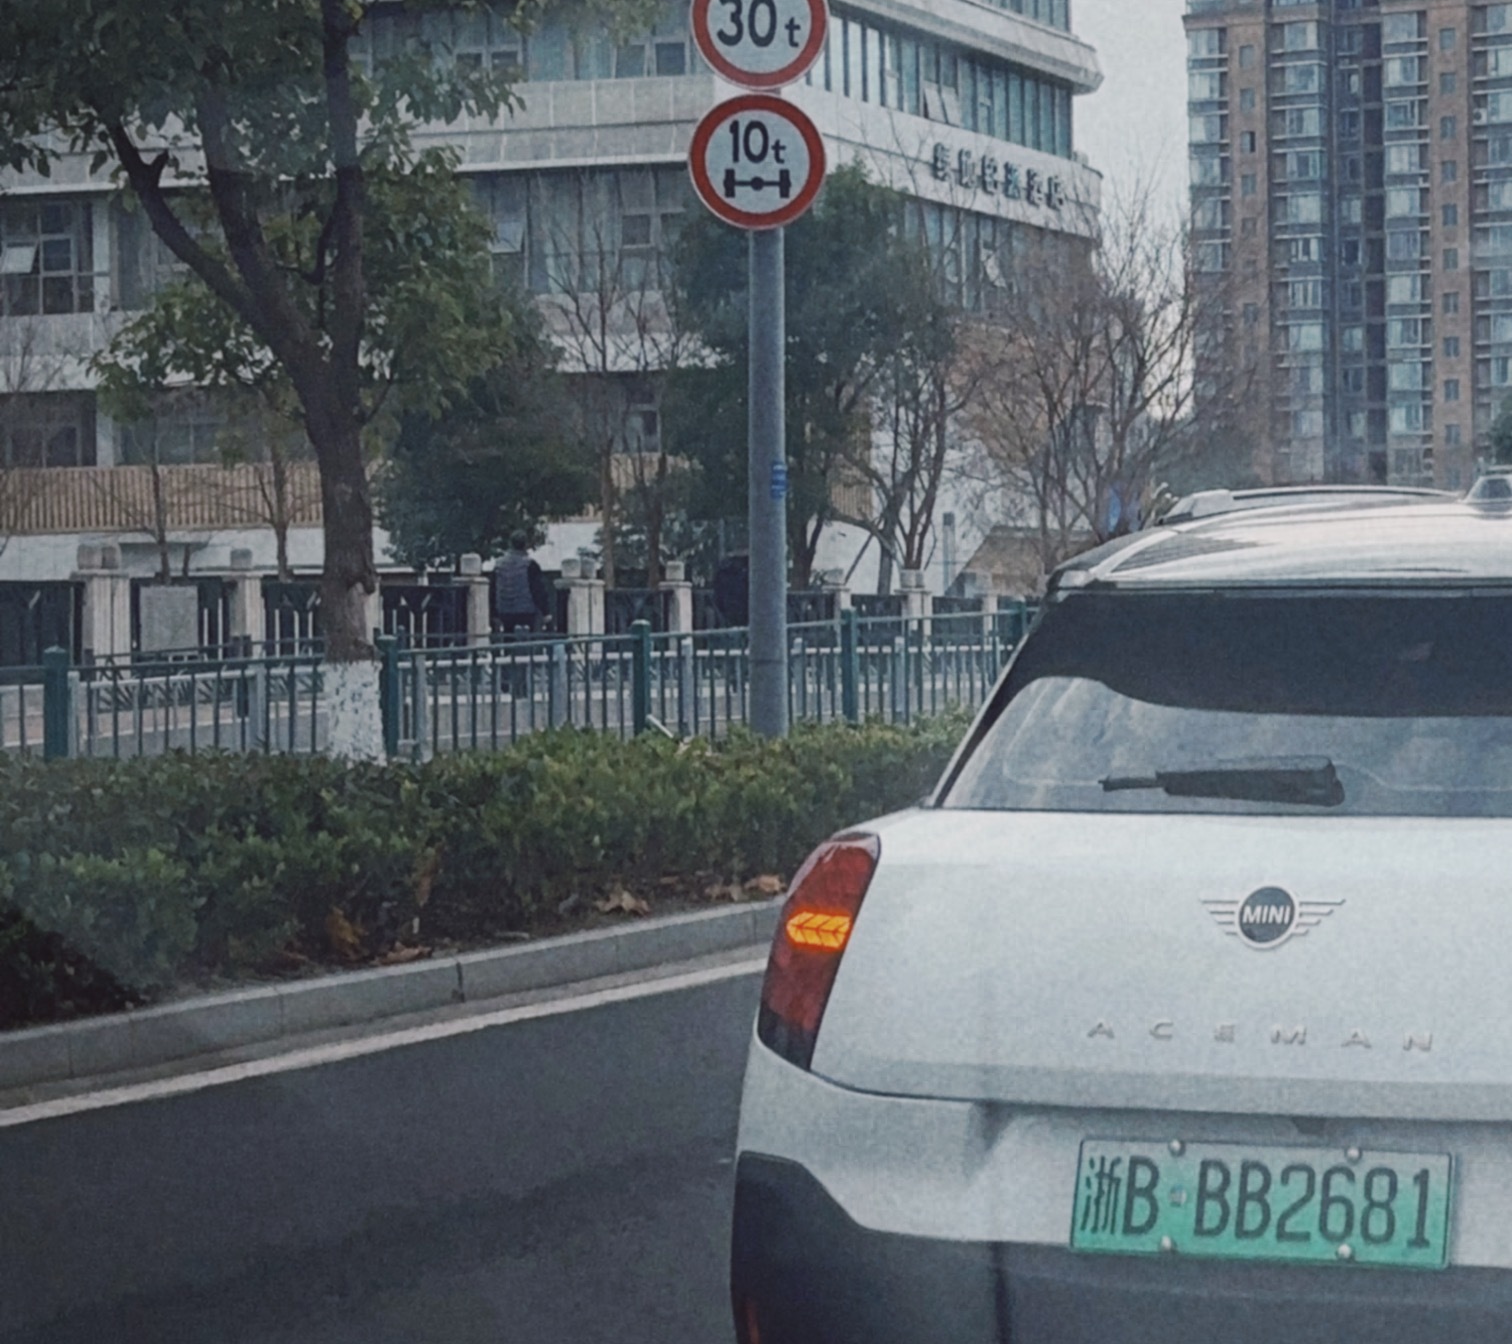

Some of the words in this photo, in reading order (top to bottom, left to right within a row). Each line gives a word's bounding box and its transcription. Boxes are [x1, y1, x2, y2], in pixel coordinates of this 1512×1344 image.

[729, 119, 786, 164] 10t
[1242, 904, 1291, 925] MINI
[1087, 1021, 1434, 1052] ACEMAN
